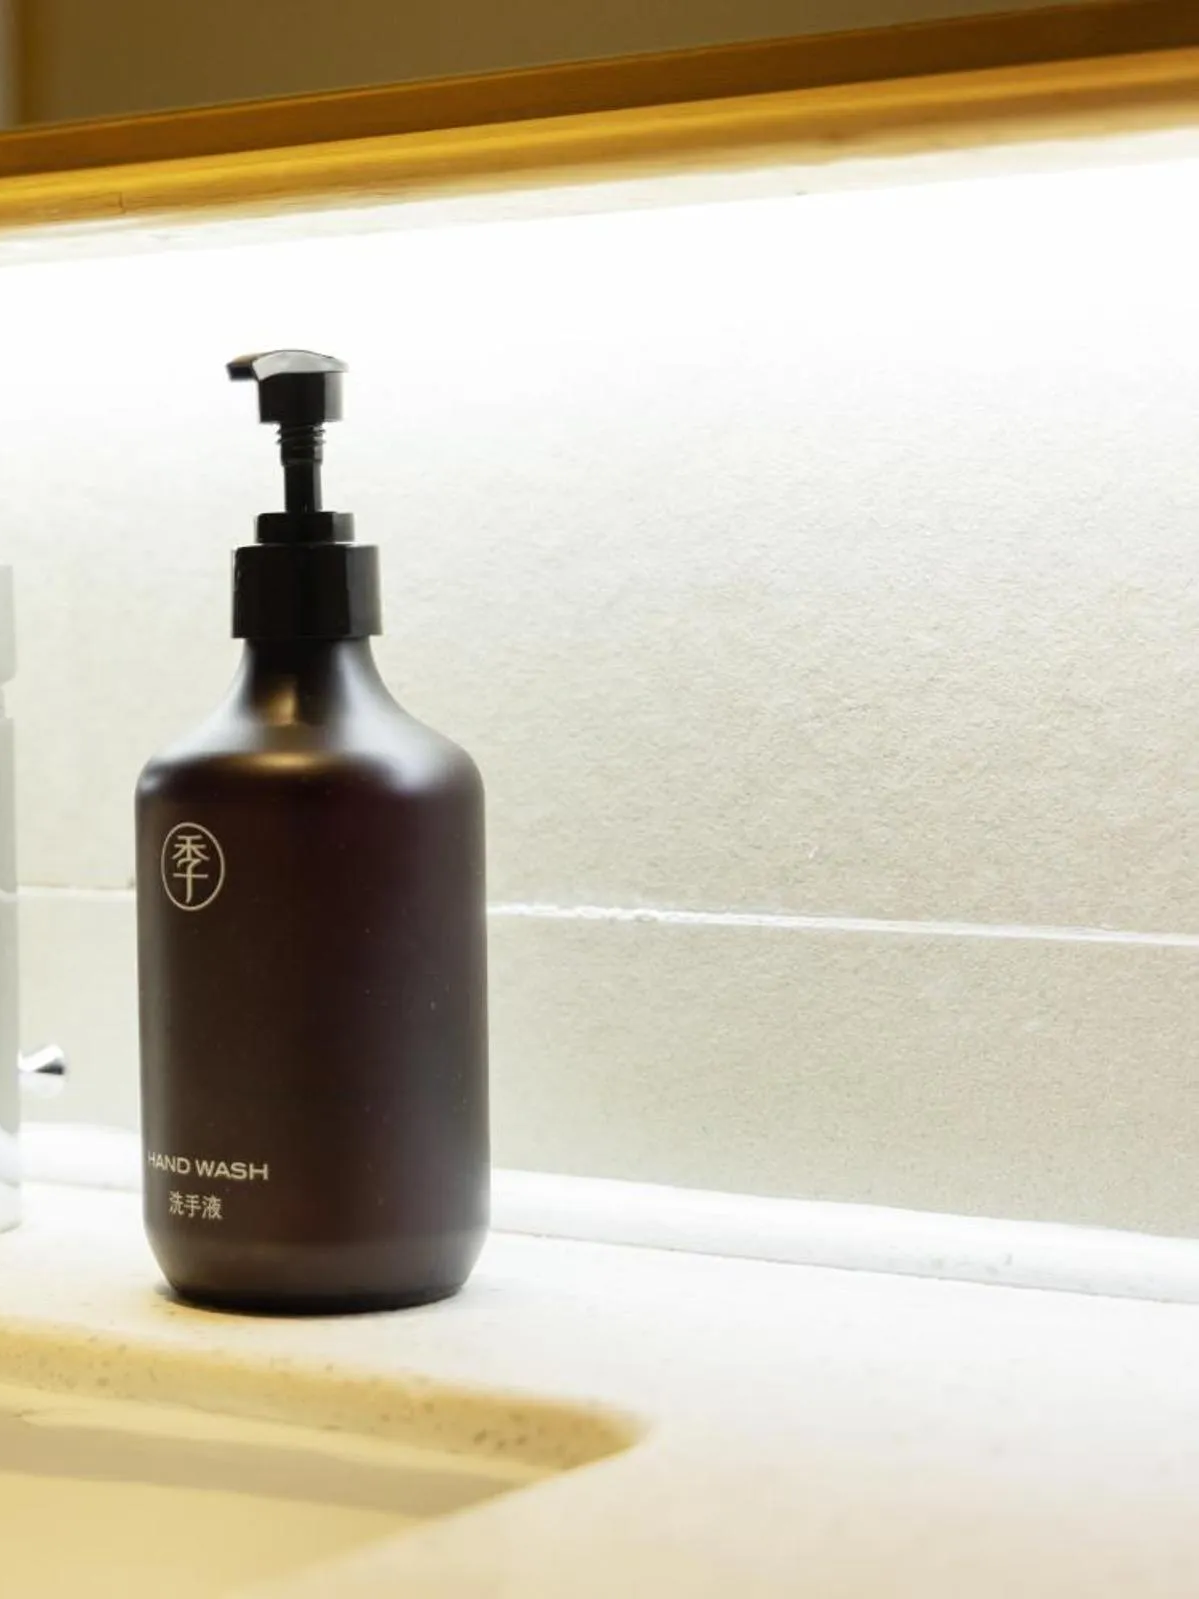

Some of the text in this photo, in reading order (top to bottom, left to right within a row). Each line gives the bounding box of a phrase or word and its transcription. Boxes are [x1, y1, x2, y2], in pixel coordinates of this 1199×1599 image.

[147, 1151, 269, 1181] HAND WASH
[168, 1191, 224, 1220] 洗手液
